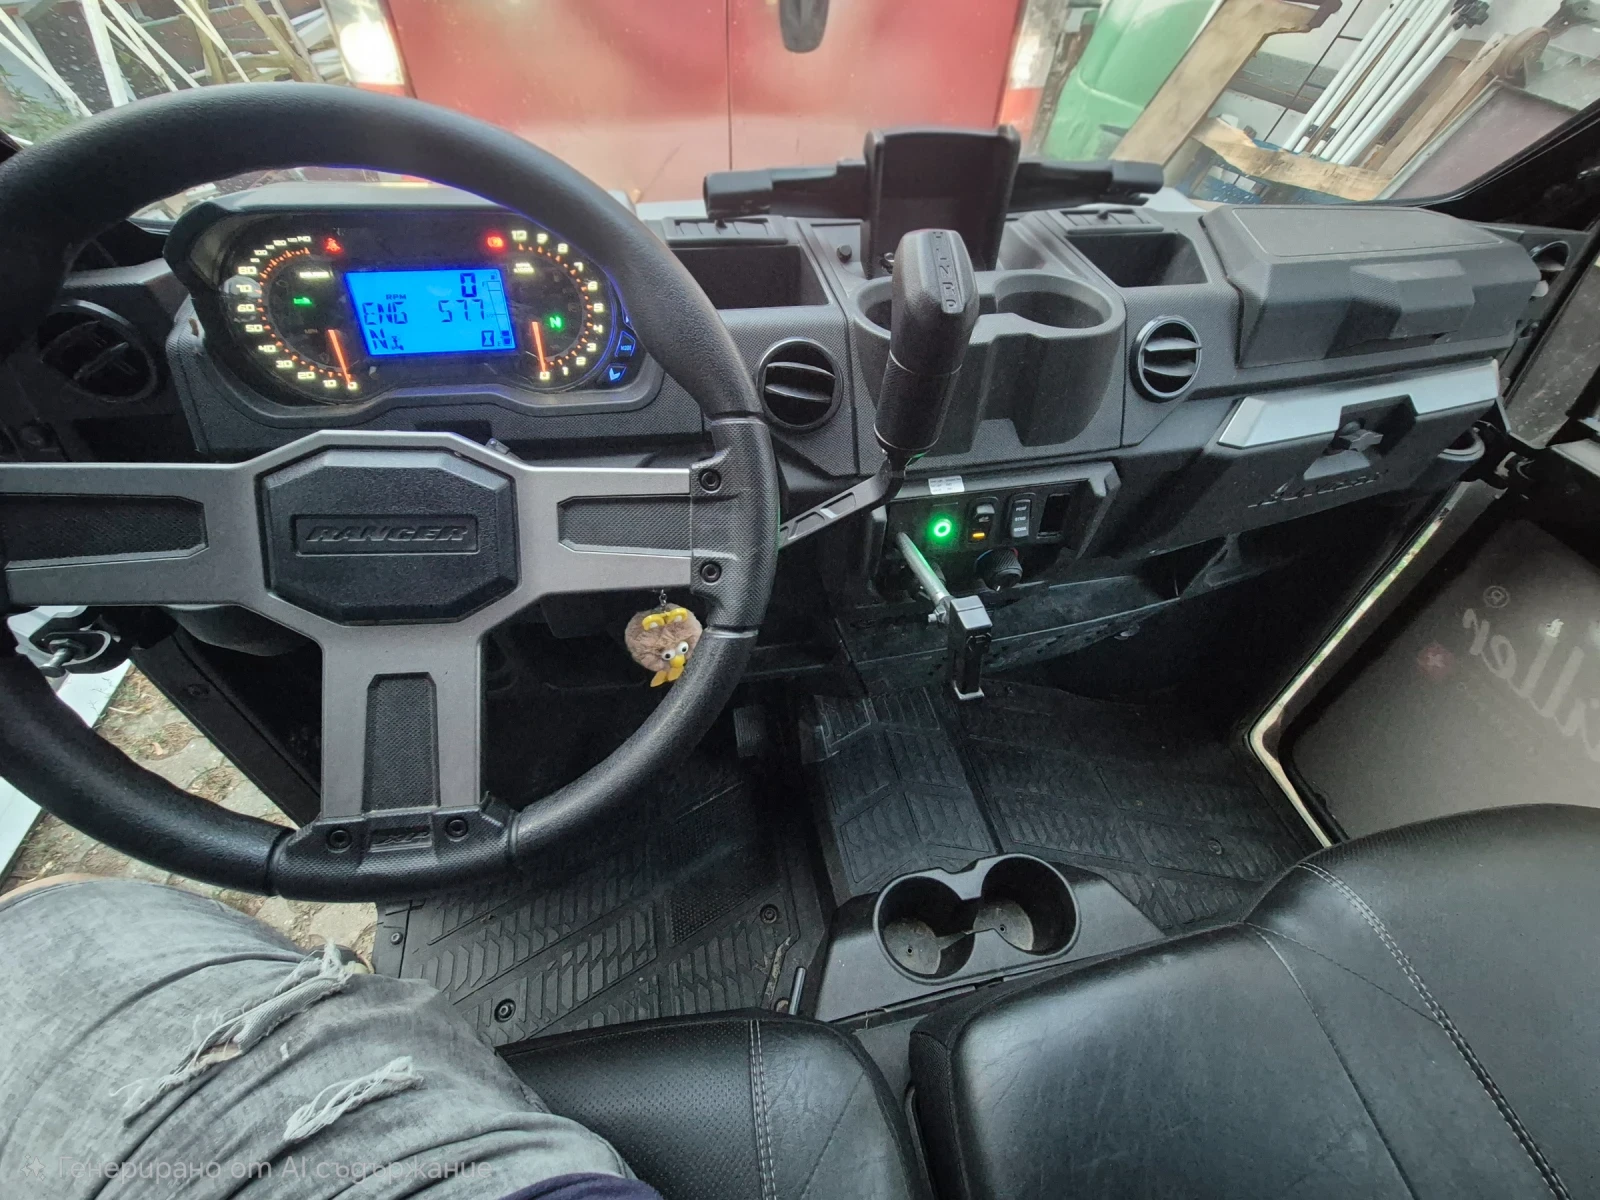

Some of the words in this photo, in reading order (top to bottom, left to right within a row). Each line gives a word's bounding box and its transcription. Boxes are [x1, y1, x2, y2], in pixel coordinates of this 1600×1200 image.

[511, 230, 527, 241] 10
[537, 233, 548, 244] 9
[237, 266, 257, 275] 80
[573, 261, 584, 272] 7
[235, 284, 253, 293] 70
[587, 281, 598, 291] 6
[237, 303, 256, 312] 60
[593, 302, 604, 313] 5
[362, 301, 408, 325] ENG
[549, 316, 562, 329] N
[245, 324, 264, 333] 50
[592, 324, 603, 334] 4
[258, 344, 277, 353] 40
[586, 342, 597, 352] 3
[275, 360, 293, 368] 30
[575, 356, 587, 366] 2
[297, 371, 316, 380] 20
[539, 371, 551, 381] 0
[562, 366, 569, 376] 1
[322, 379, 337, 388] 10
[347, 381, 358, 390] 0
[305, 525, 468, 542] RANGER
